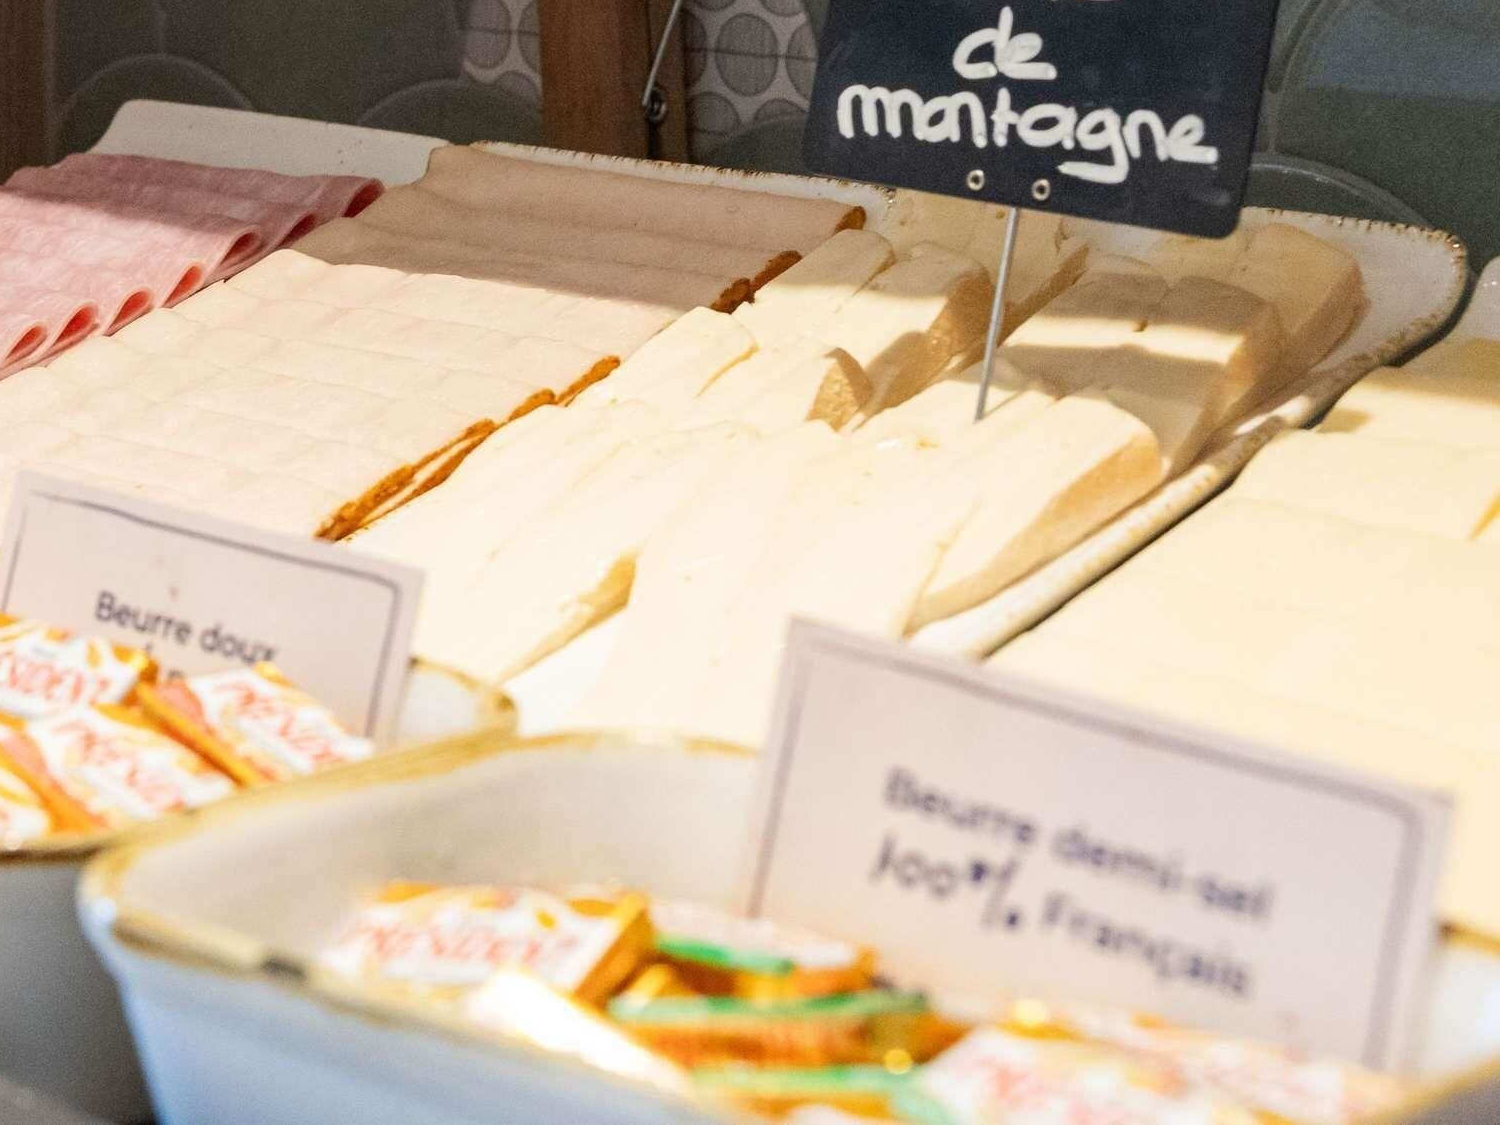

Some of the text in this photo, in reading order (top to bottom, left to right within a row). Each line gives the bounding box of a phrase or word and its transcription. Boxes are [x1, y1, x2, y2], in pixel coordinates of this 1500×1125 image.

[952, 6, 1057, 80] de
[837, 84, 1218, 183] montagne
[94, 590, 191, 646] Beurre
[199, 623, 279, 664] doux
[883, 766, 1275, 921] Beurre demi-sel
[869, 834, 1253, 1000] 100% Français
